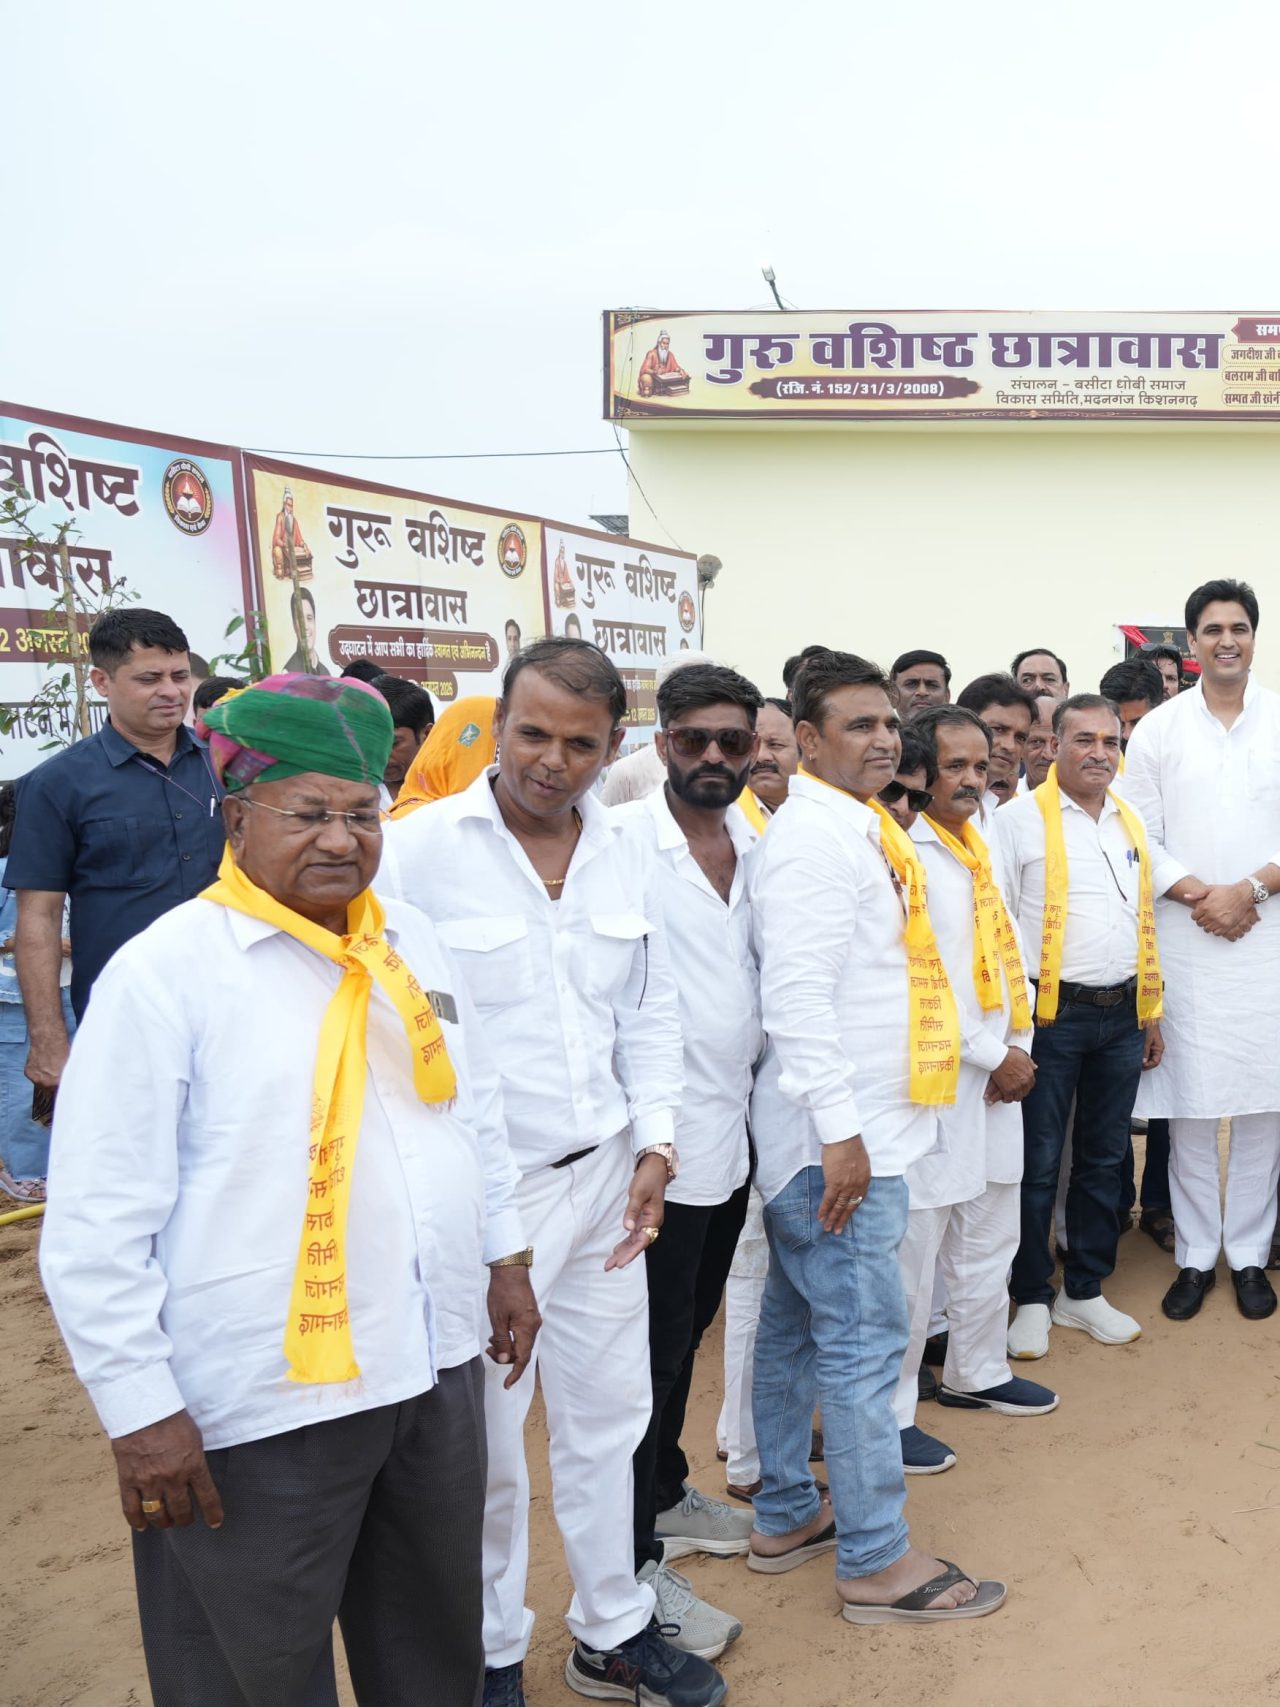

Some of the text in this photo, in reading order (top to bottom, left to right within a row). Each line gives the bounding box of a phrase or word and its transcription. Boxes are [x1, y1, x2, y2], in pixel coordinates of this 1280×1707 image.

[809, 322, 978, 370] वशिष्ठ
[989, 333, 1226, 370] छात्रावास
[1231, 347, 1263, 361] जगदीश
[1265, 347, 1276, 361] जी
[1010, 376, 1058, 390] संचालन
[1074, 376, 1112, 390] बसीटा
[1116, 376, 1146, 391] धोबी
[1150, 380, 1187, 391] समाज
[1225, 369, 1254, 382] बलराम
[1255, 368, 1267, 382] जी
[827, 380, 945, 397] 152/31/3/2008)
[996, 391, 1037, 405] विकास
[1139, 391, 1199, 408] किशनगढ़
[1224, 392, 1249, 404] सम्पत
[1250, 391, 1261, 404] जी
[354, 580, 468, 625] छात्रावास
[592, 619, 667, 657] छात्रावास
[374, 641, 389, 657] आप
[389, 636, 405, 657] सभी
[405, 642, 416, 657] का
[485, 640, 491, 662] है
